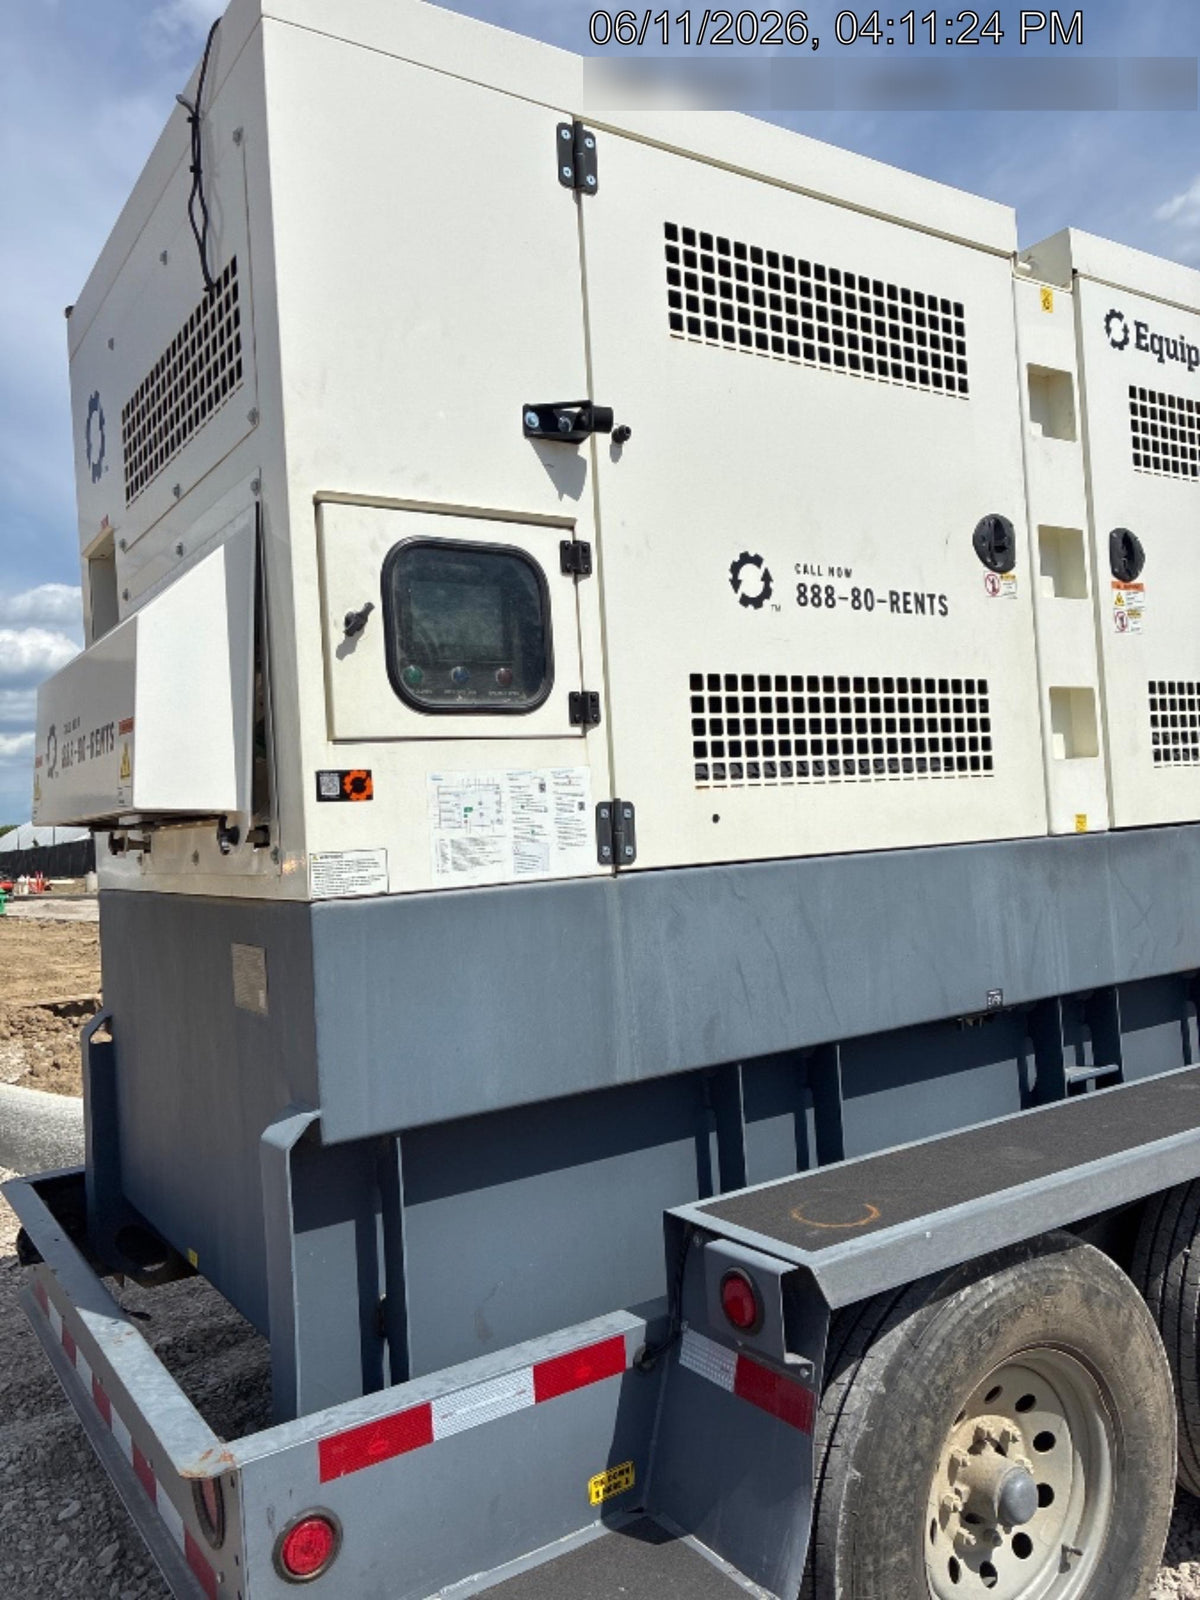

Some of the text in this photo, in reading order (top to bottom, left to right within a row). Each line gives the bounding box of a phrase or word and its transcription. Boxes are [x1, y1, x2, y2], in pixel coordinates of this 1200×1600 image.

[1133, 319, 1200, 373] Equip
[794, 563, 853, 579] CALL NOW
[796, 582, 949, 617] 888-80-RENTS
